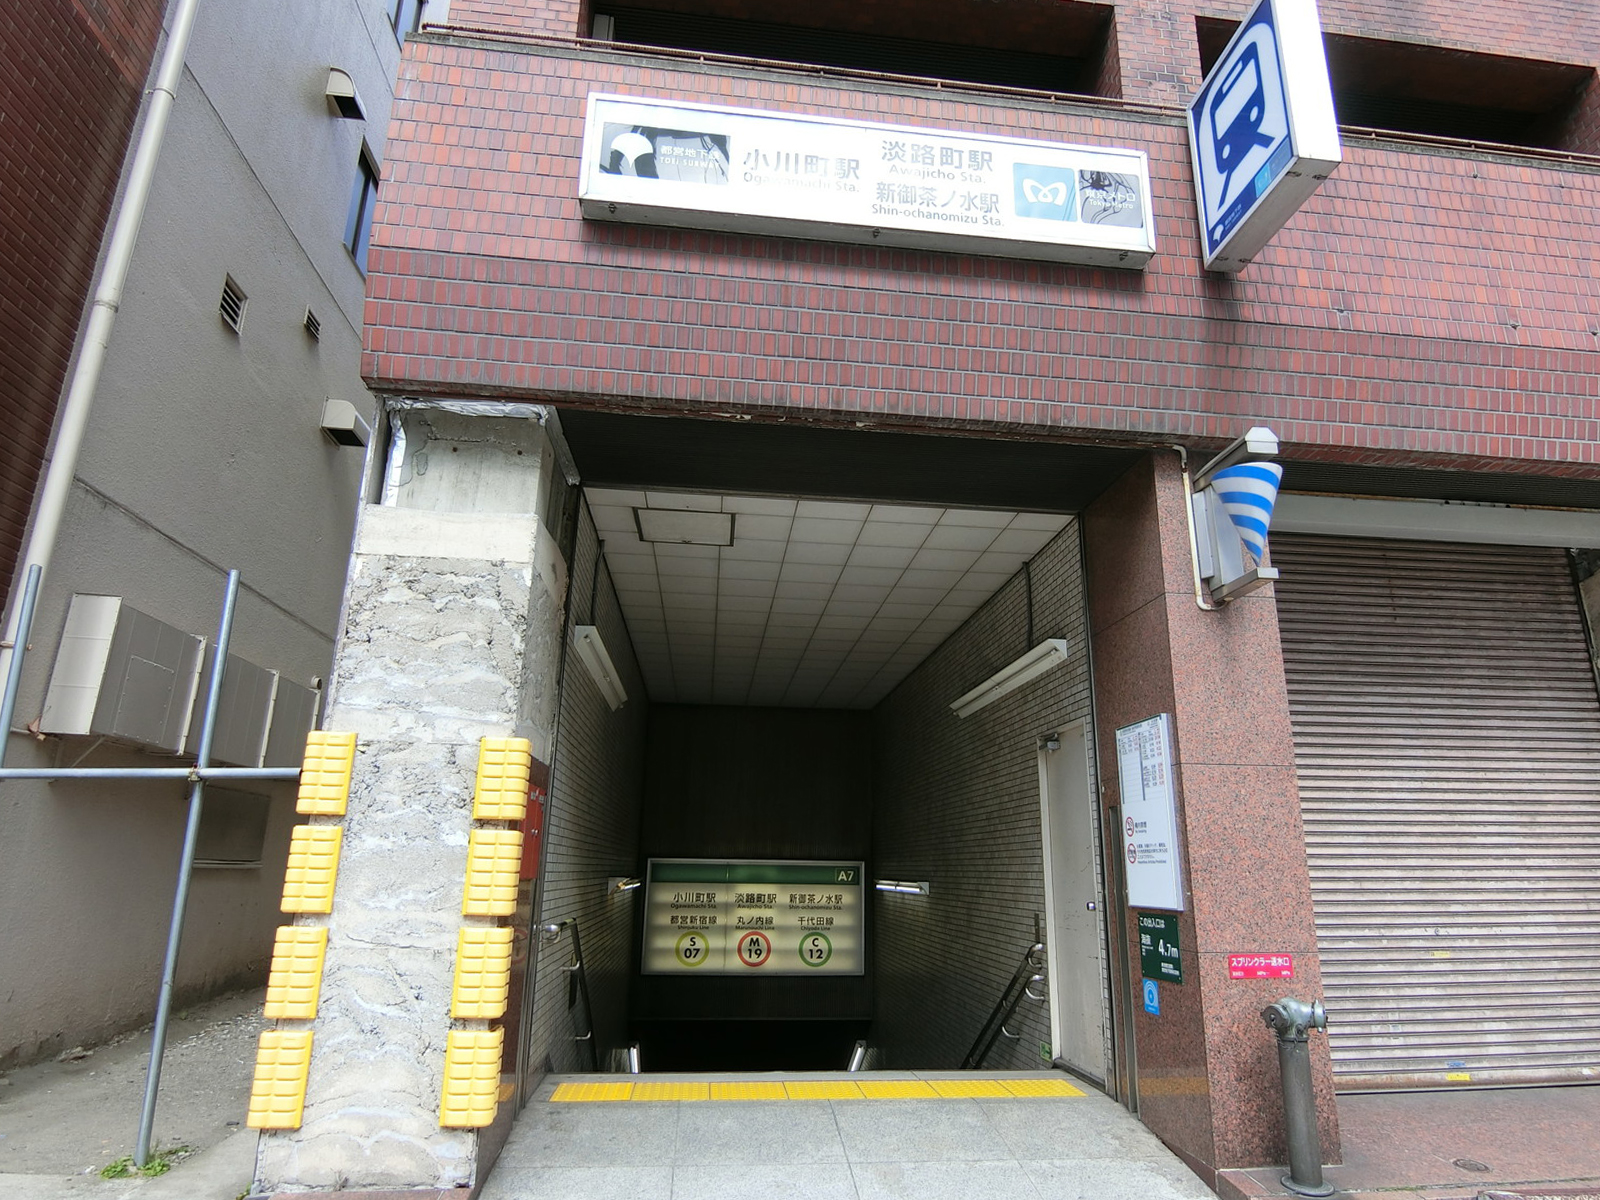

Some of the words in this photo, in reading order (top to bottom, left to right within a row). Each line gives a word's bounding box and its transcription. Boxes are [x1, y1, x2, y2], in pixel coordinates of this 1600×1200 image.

[881, 140, 993, 172] 淡路町駅
[743, 148, 860, 180] 小川町駅
[889, 163, 955, 181] Awajicho
[960, 170, 986, 184] Sta.
[835, 180, 860, 193] Sta.
[876, 181, 1000, 214] 新御茶ノ水駅
[872, 203, 978, 224] Shin-ochanomizu
[982, 214, 1005, 228] Sta.
[837, 870, 854, 882] A7
[673, 892, 716, 903] 小川町駅
[734, 892, 777, 904] 淡路町駅
[789, 893, 843, 905] 新御茶ノ水駅
[670, 915, 718, 925] 都営新宿線
[736, 916, 774, 926] 丸ノ内線
[797, 916, 834, 926] 千代田線
[689, 937, 697, 947] S
[748, 937, 760, 947] M
[811, 937, 820, 947] C
[1158, 938, 1179, 958] 4.7m
[684, 948, 701, 959] 07
[747, 948, 763, 960] 19
[808, 948, 824, 959] 12
[1231, 956, 1290, 967] スプリンクラー送水口
